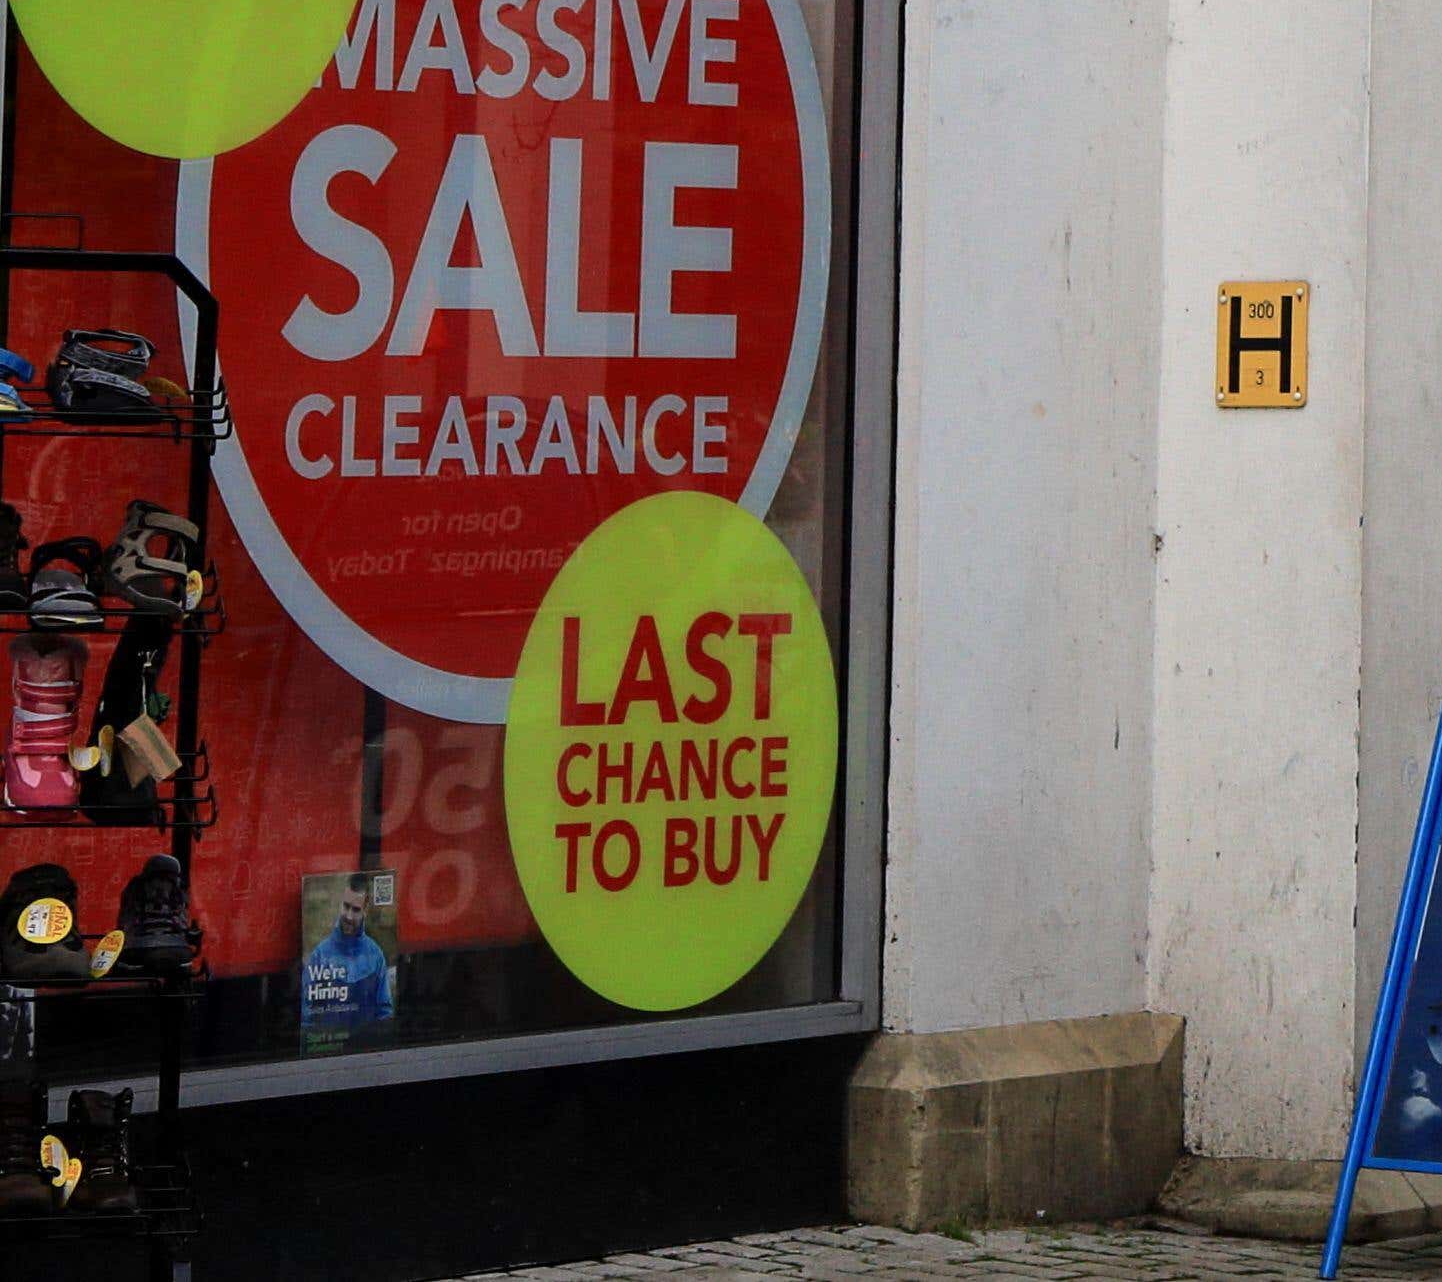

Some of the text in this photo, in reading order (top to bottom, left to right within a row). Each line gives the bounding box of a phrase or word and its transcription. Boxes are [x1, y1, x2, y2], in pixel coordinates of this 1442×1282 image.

[281, 123, 740, 361] SALE
[1229, 295, 1293, 394] H
[1248, 303, 1275, 319] 300
[1255, 370, 1265, 386] 3
[285, 392, 729, 480] CLEARANCE
[560, 611, 792, 727] LAST
[556, 737, 789, 807] CHANCE
[555, 813, 786, 893] TO BUY
[307, 982, 349, 1002] Hiring
[308, 964, 347, 981] We're
